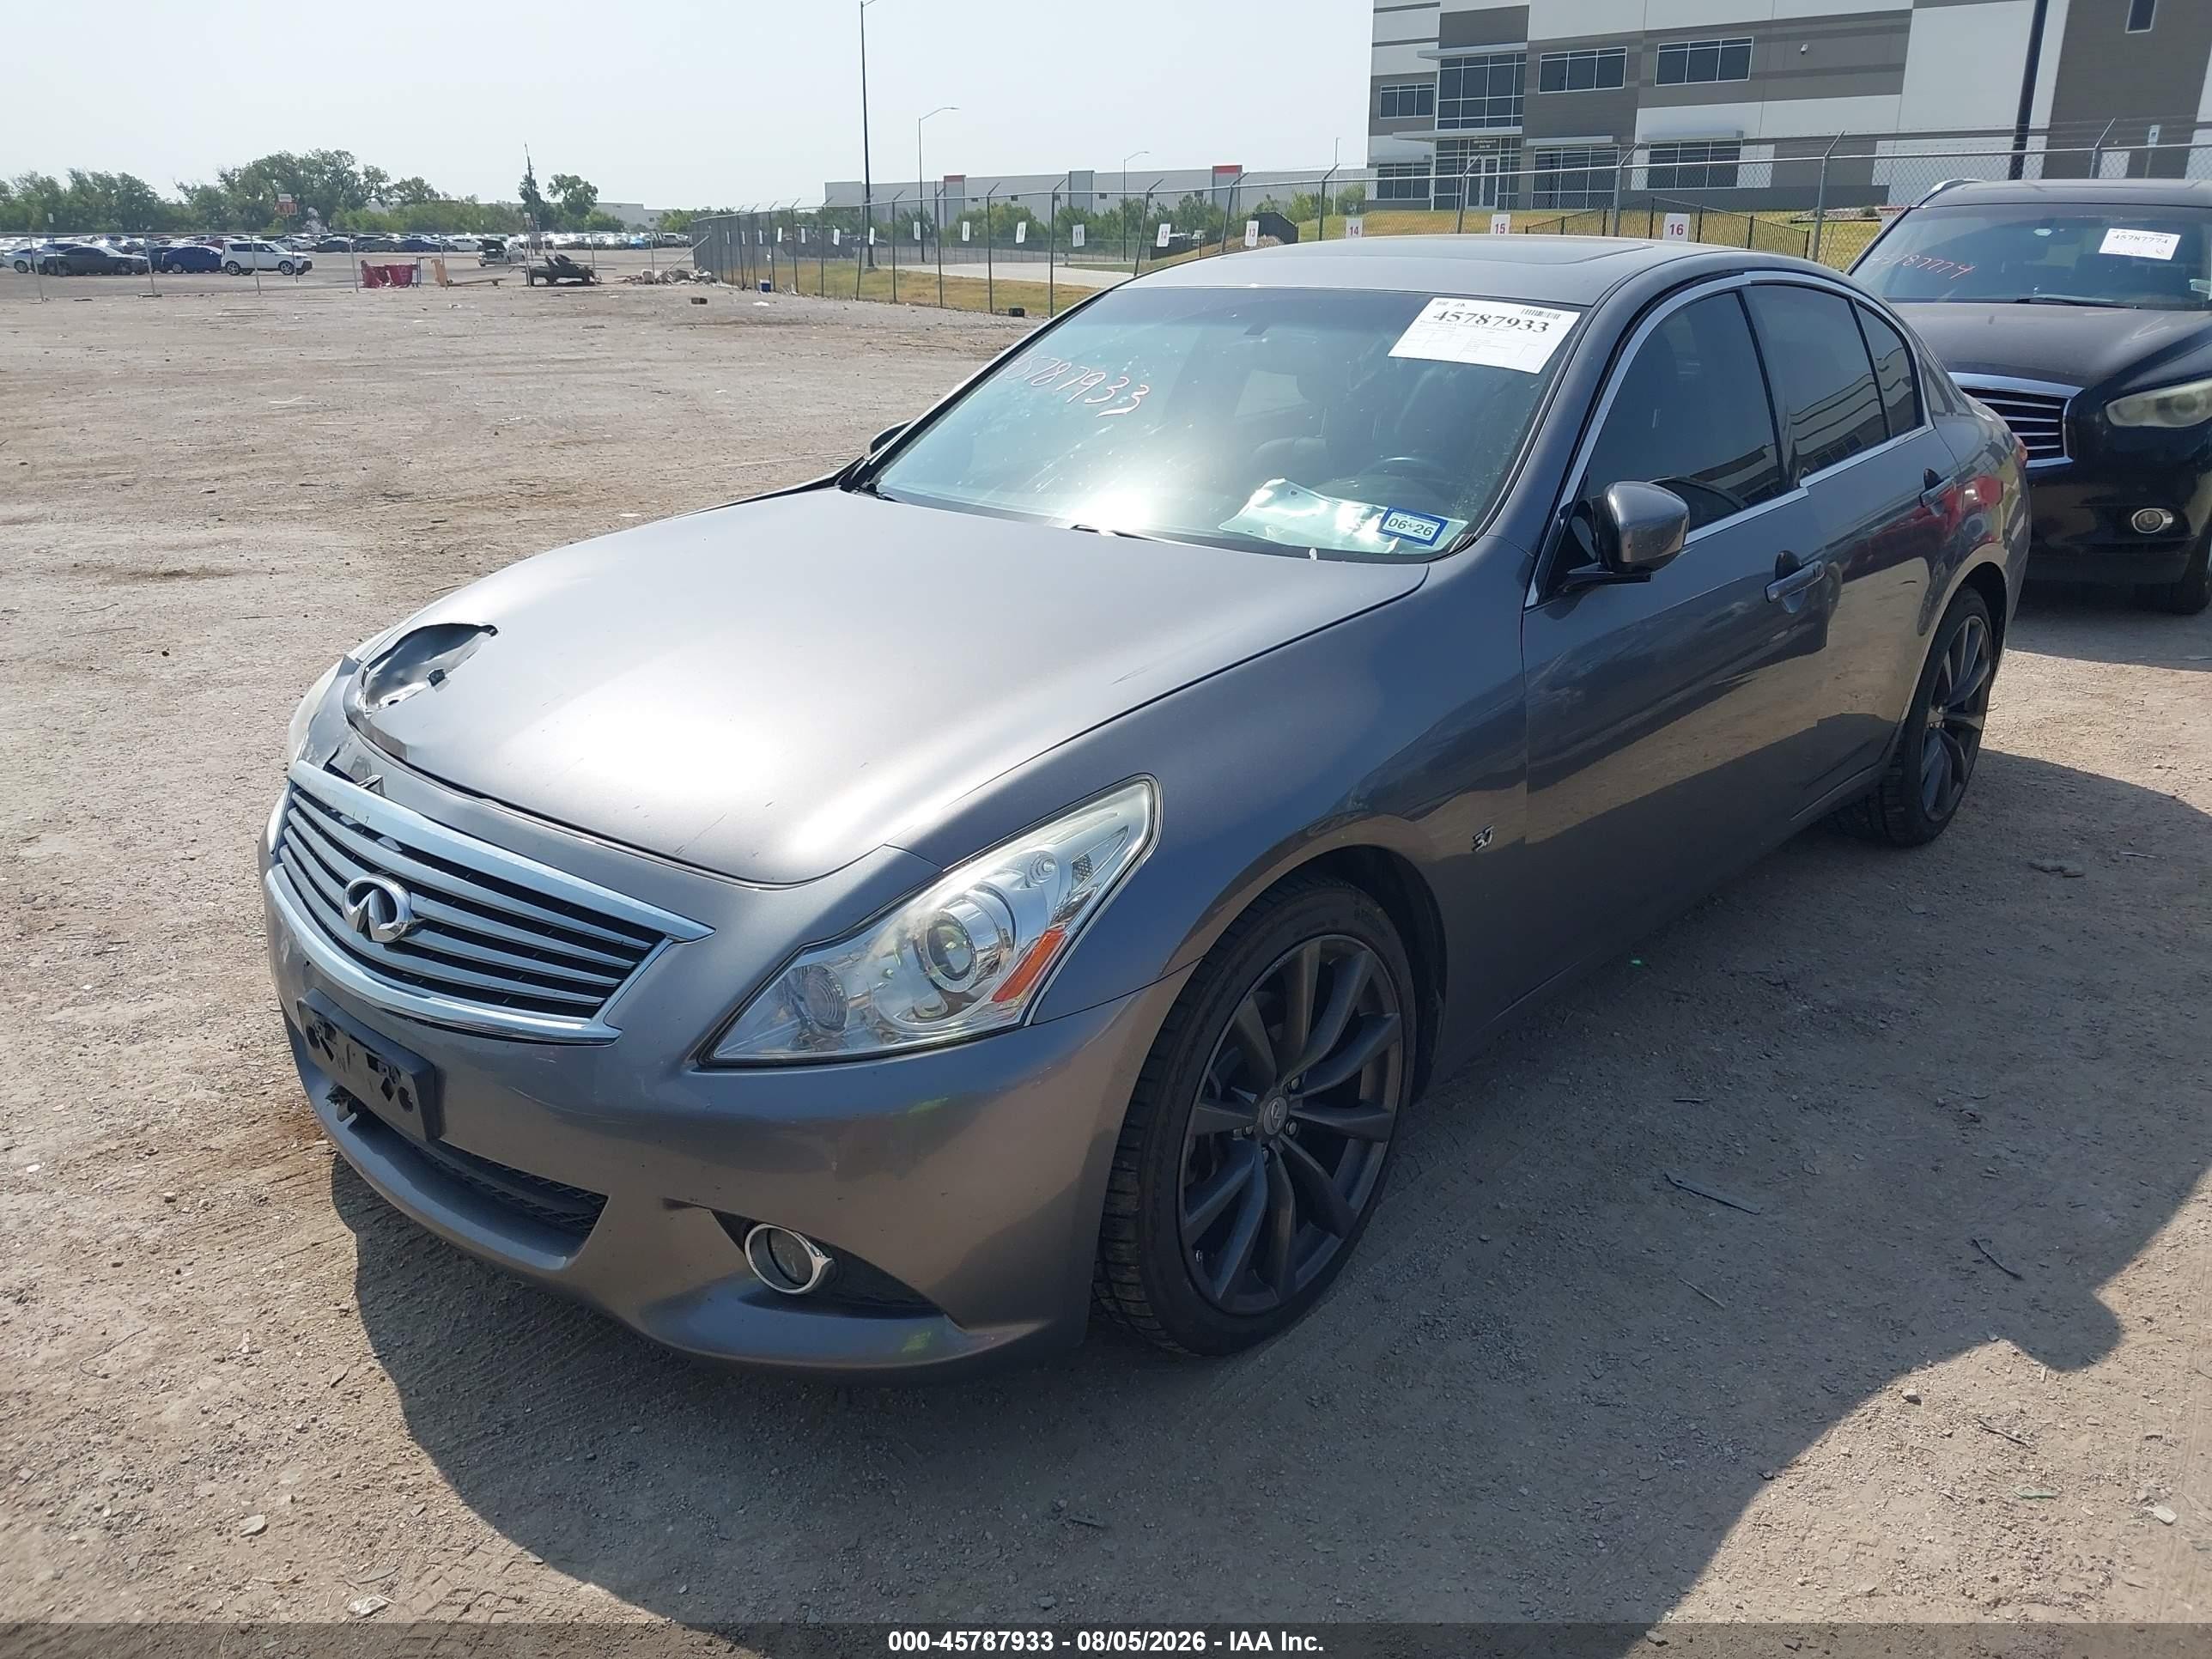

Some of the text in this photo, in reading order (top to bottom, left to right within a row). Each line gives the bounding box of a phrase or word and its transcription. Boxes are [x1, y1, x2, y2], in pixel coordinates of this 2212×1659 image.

[1249, 228, 1256, 238] 13
[1349, 226, 1359, 236] 14
[1494, 223, 1506, 234] 15
[1669, 223, 1685, 235] 16
[1432, 310, 1551, 335] 45787933
[1388, 518, 1408, 530] 06
[1413, 524, 1435, 537] 26
